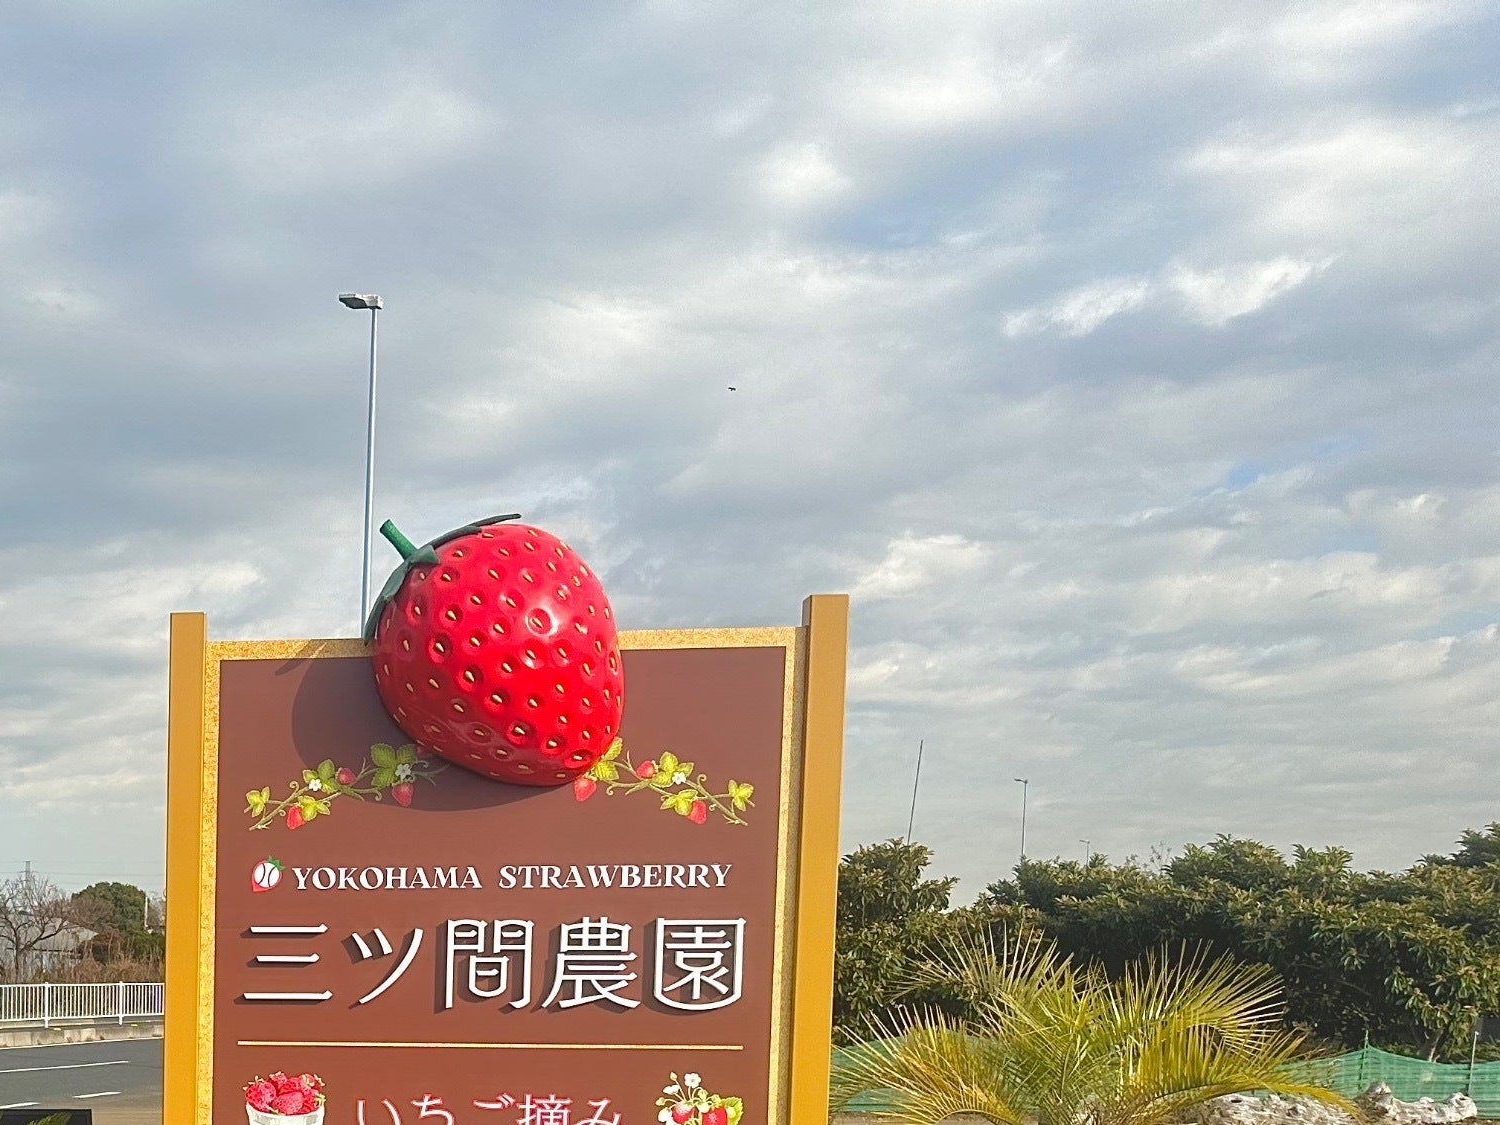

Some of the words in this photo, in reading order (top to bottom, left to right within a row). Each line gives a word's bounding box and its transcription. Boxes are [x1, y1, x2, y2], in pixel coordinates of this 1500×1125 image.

[292, 866, 482, 890] YOKOHAMA
[498, 863, 733, 889] STRAWBERRY
[242, 915, 747, 1011] 三ツ間農園
